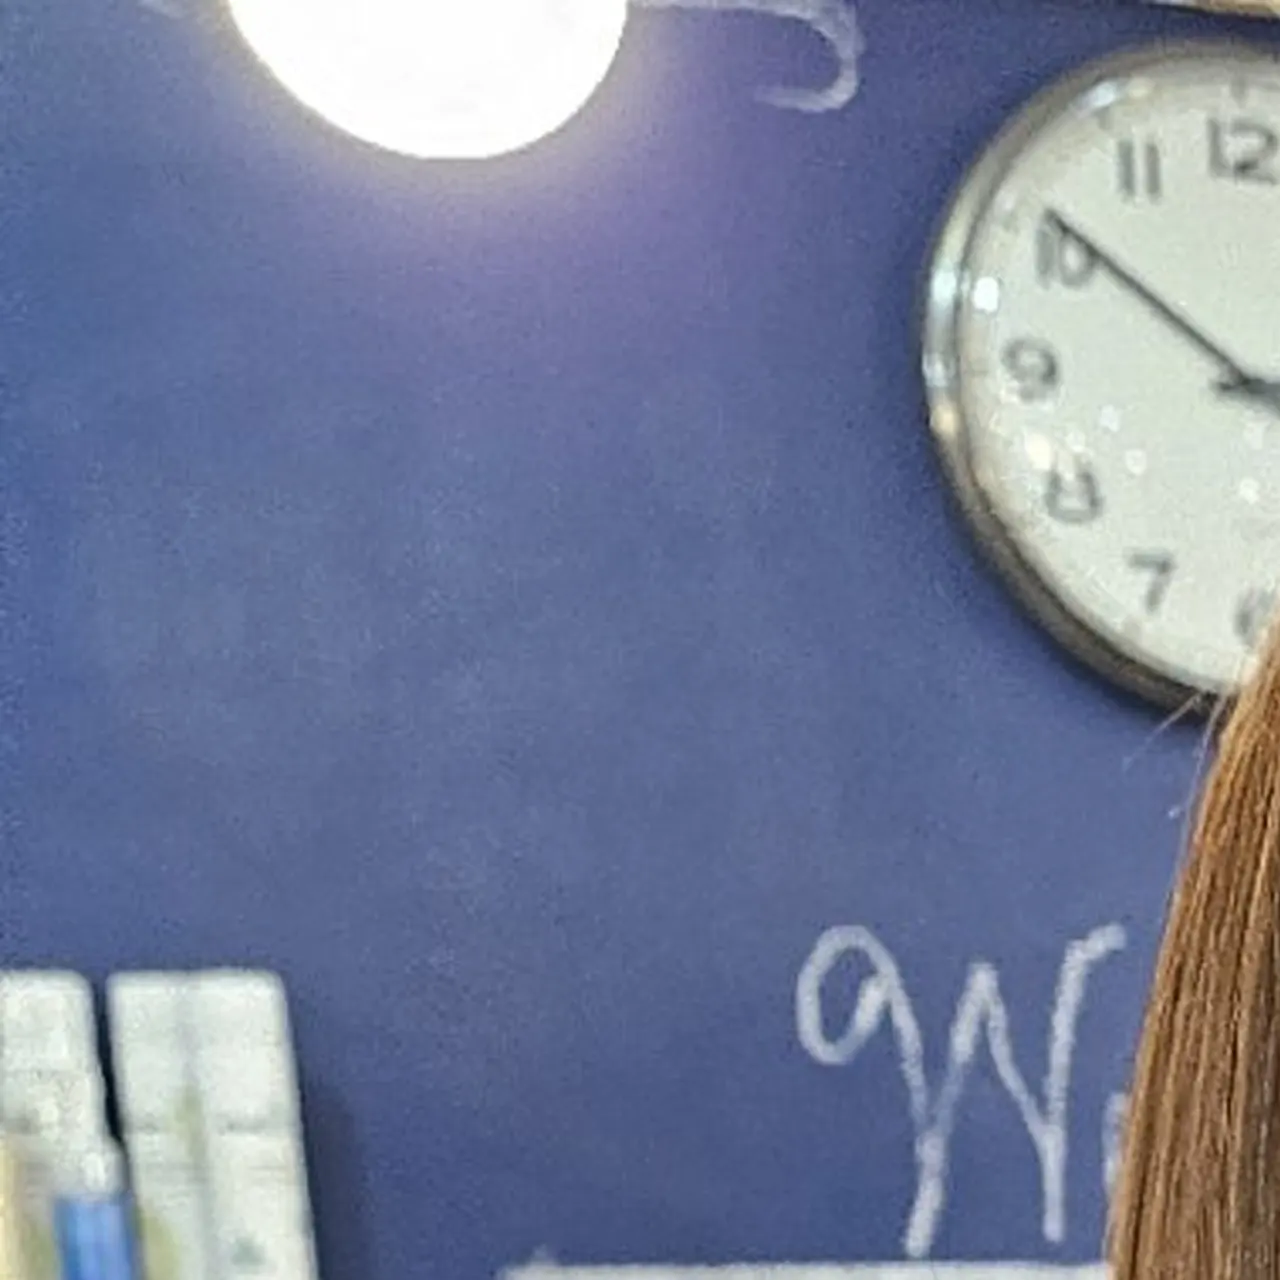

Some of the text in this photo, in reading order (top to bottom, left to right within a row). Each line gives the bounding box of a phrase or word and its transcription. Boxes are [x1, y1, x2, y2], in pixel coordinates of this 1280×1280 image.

[1116, 138, 1162, 202] 11
[1206, 118, 1279, 185] 12
[1034, 224, 1098, 290] 10
[1002, 338, 1059, 403] 9
[1128, 552, 1177, 614] 7
